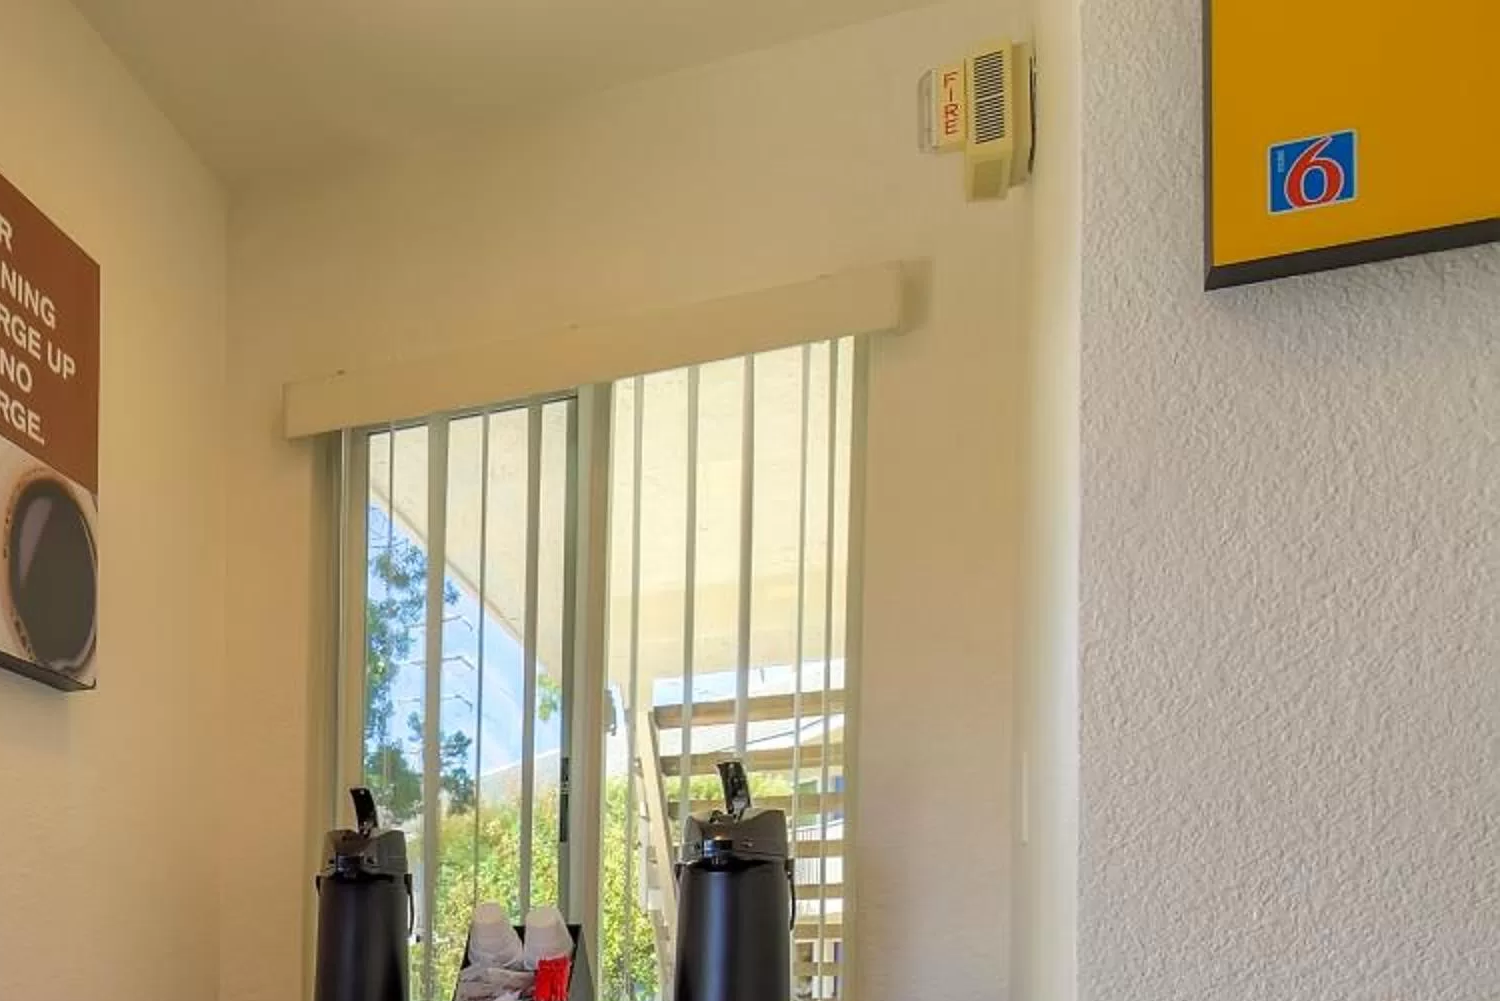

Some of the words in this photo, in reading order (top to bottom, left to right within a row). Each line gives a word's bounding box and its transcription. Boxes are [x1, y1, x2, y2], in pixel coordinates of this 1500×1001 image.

[943, 71, 959, 136] FIRE
[1284, 136, 1345, 208] 6
[0, 348, 33, 393] NO
[47, 341, 77, 380] UP
